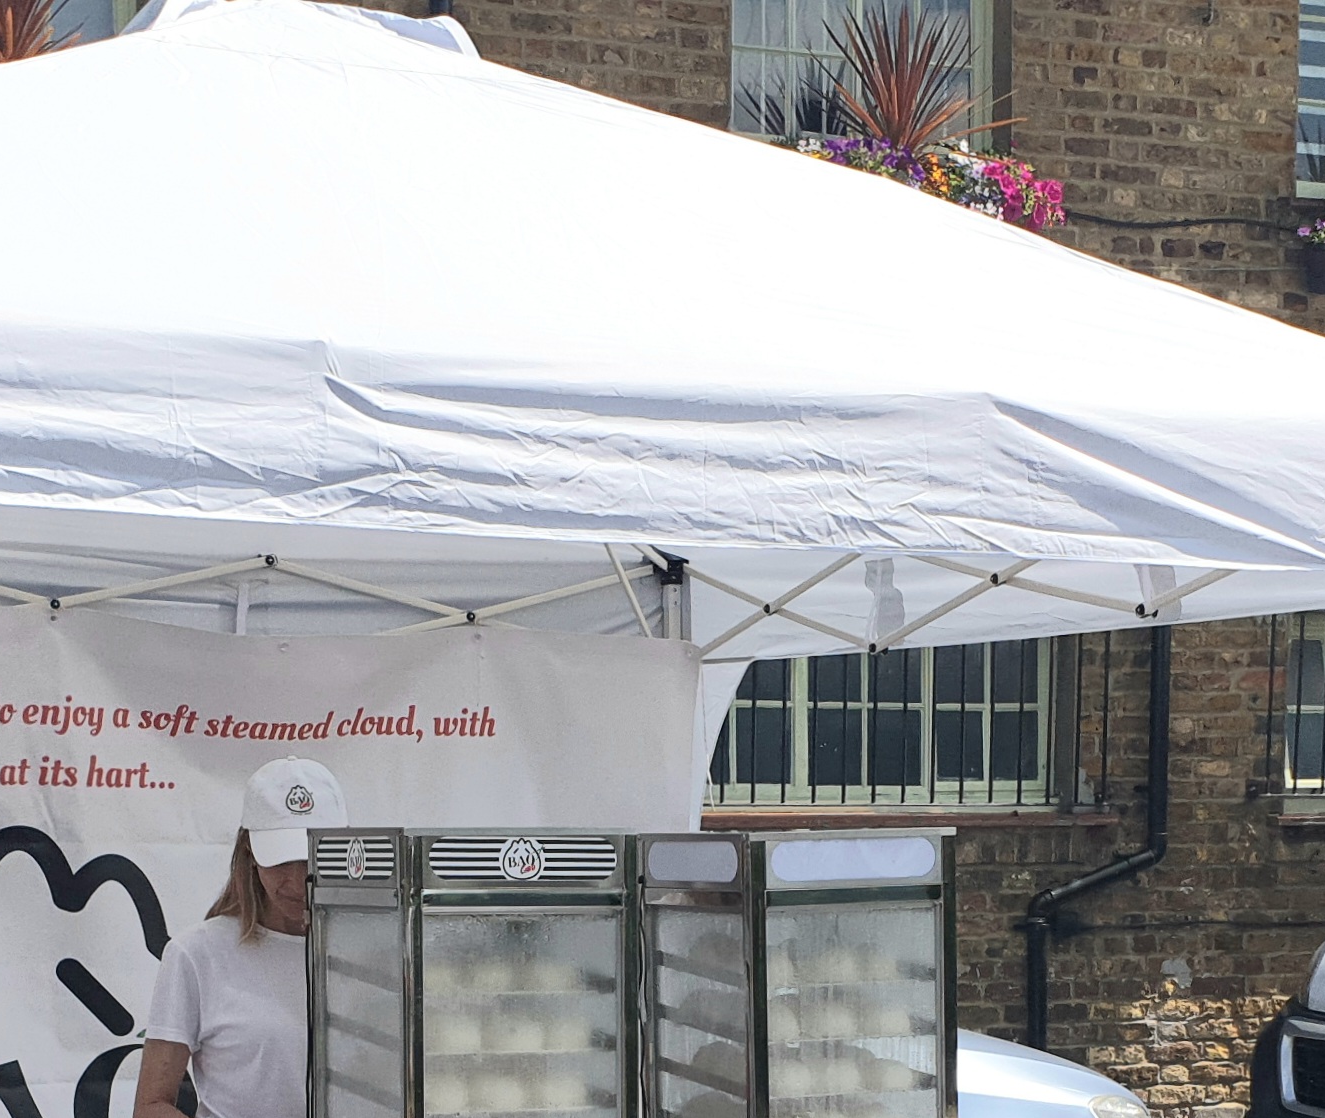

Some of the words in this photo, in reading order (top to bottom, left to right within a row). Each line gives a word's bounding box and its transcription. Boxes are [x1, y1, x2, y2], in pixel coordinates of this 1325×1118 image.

[22, 695, 104, 736] enjoy
[113, 707, 130, 728] a
[138, 704, 200, 738] soft
[203, 711, 334, 741] steamed
[337, 704, 424, 743] cloud,
[433, 706, 496, 737] with
[0, 758, 31, 785] at
[38, 755, 78, 787] its
[86, 754, 176, 789] hart...
